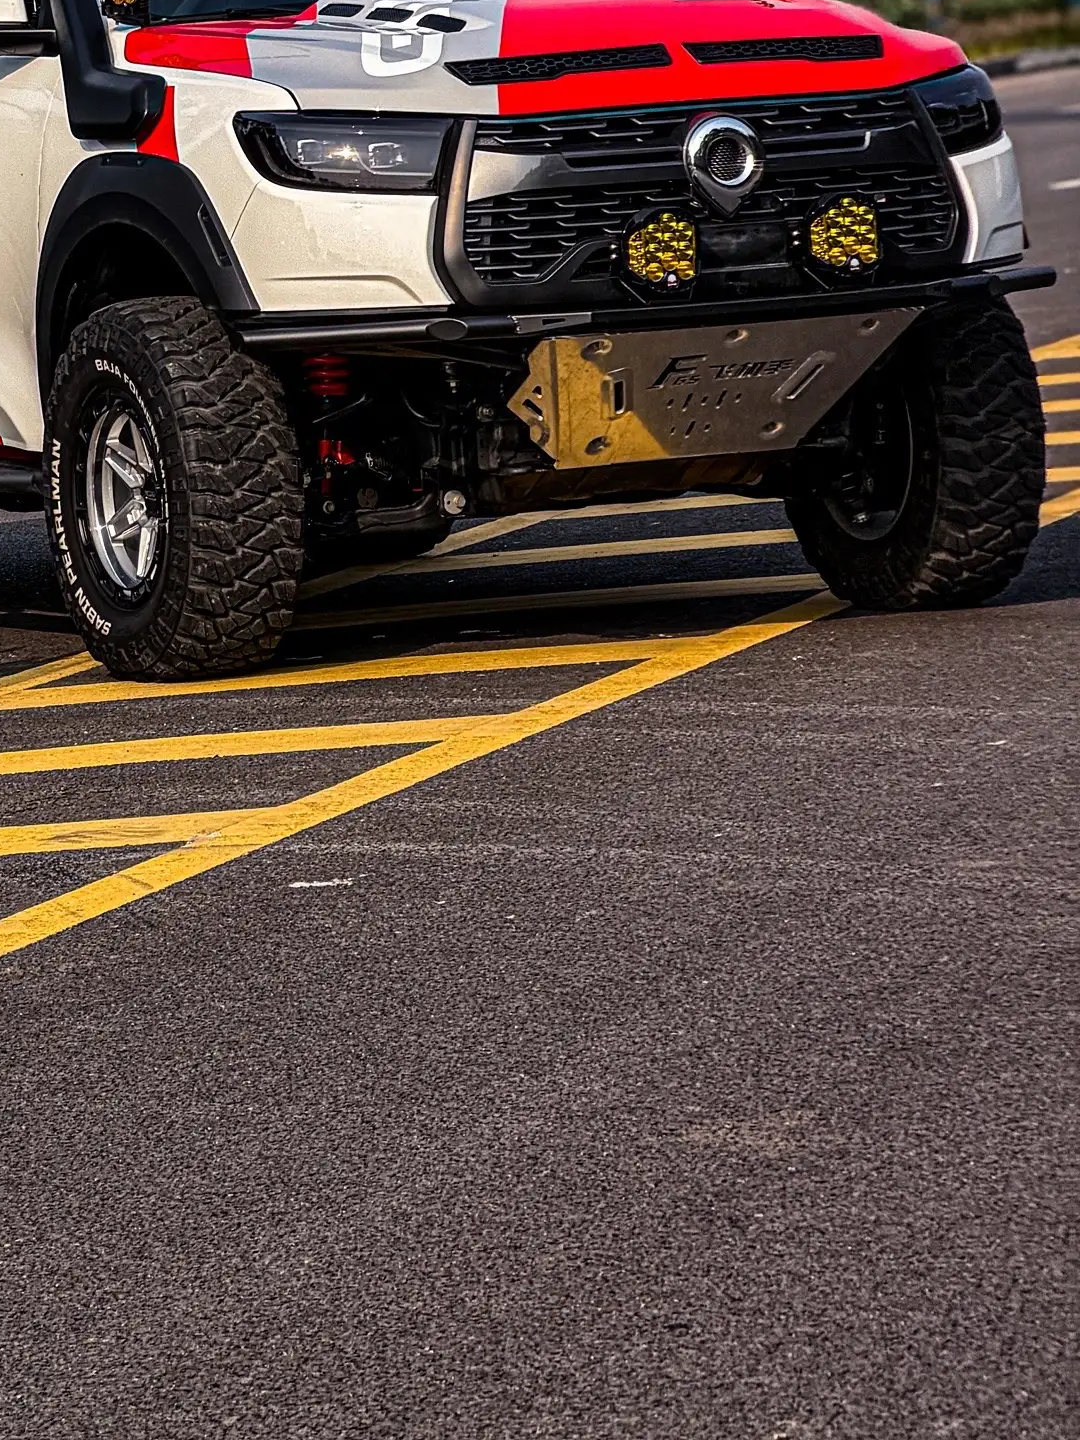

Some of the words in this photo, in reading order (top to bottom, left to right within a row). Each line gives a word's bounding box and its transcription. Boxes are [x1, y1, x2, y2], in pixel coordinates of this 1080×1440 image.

[94, 359, 122, 379] BAJA
[49, 437, 78, 584] PEARLMAN
[73, 589, 113, 637] SABIN
